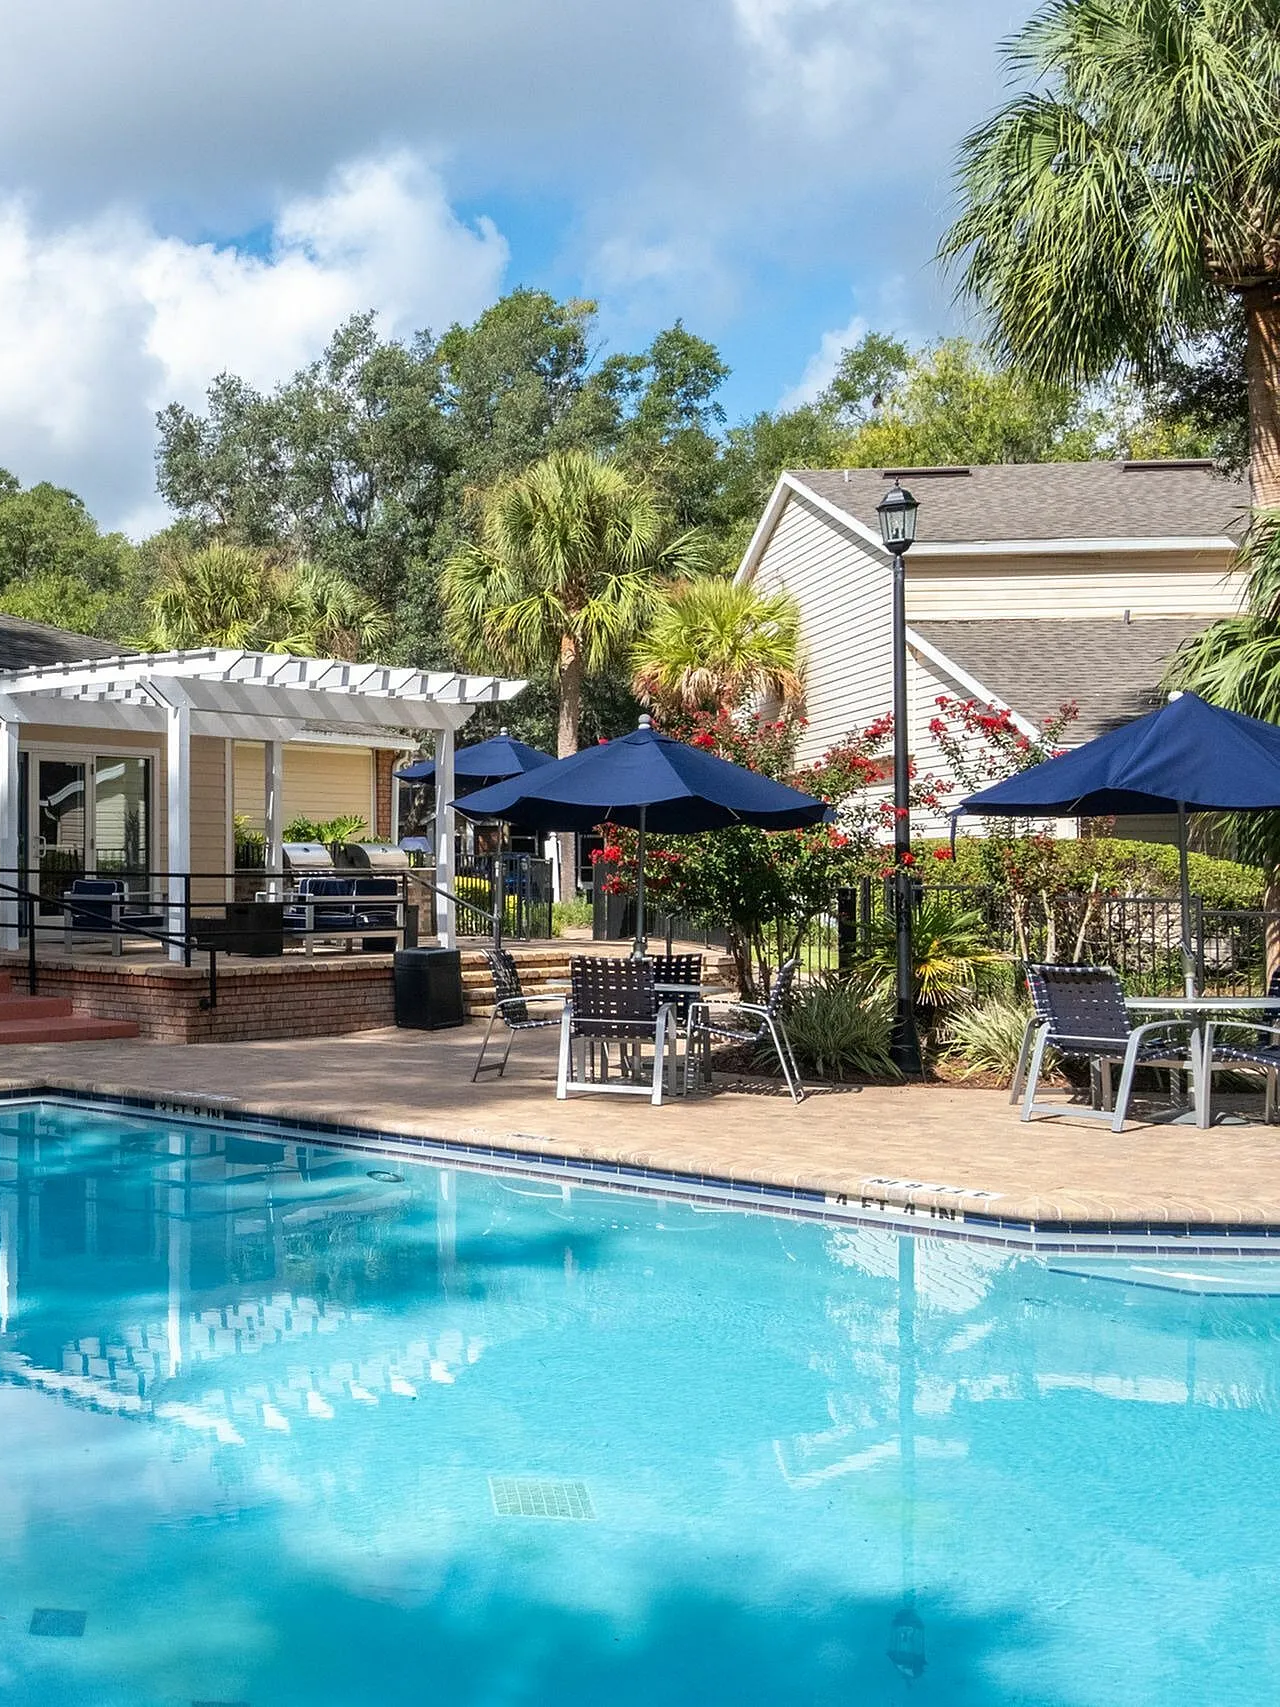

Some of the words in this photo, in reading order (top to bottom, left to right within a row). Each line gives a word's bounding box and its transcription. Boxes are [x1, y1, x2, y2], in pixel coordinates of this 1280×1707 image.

[172, 1103, 188, 1114] FT
[207, 1106, 220, 1118] IN
[861, 1196, 889, 1211] FT
[930, 1205, 956, 1221] IN
